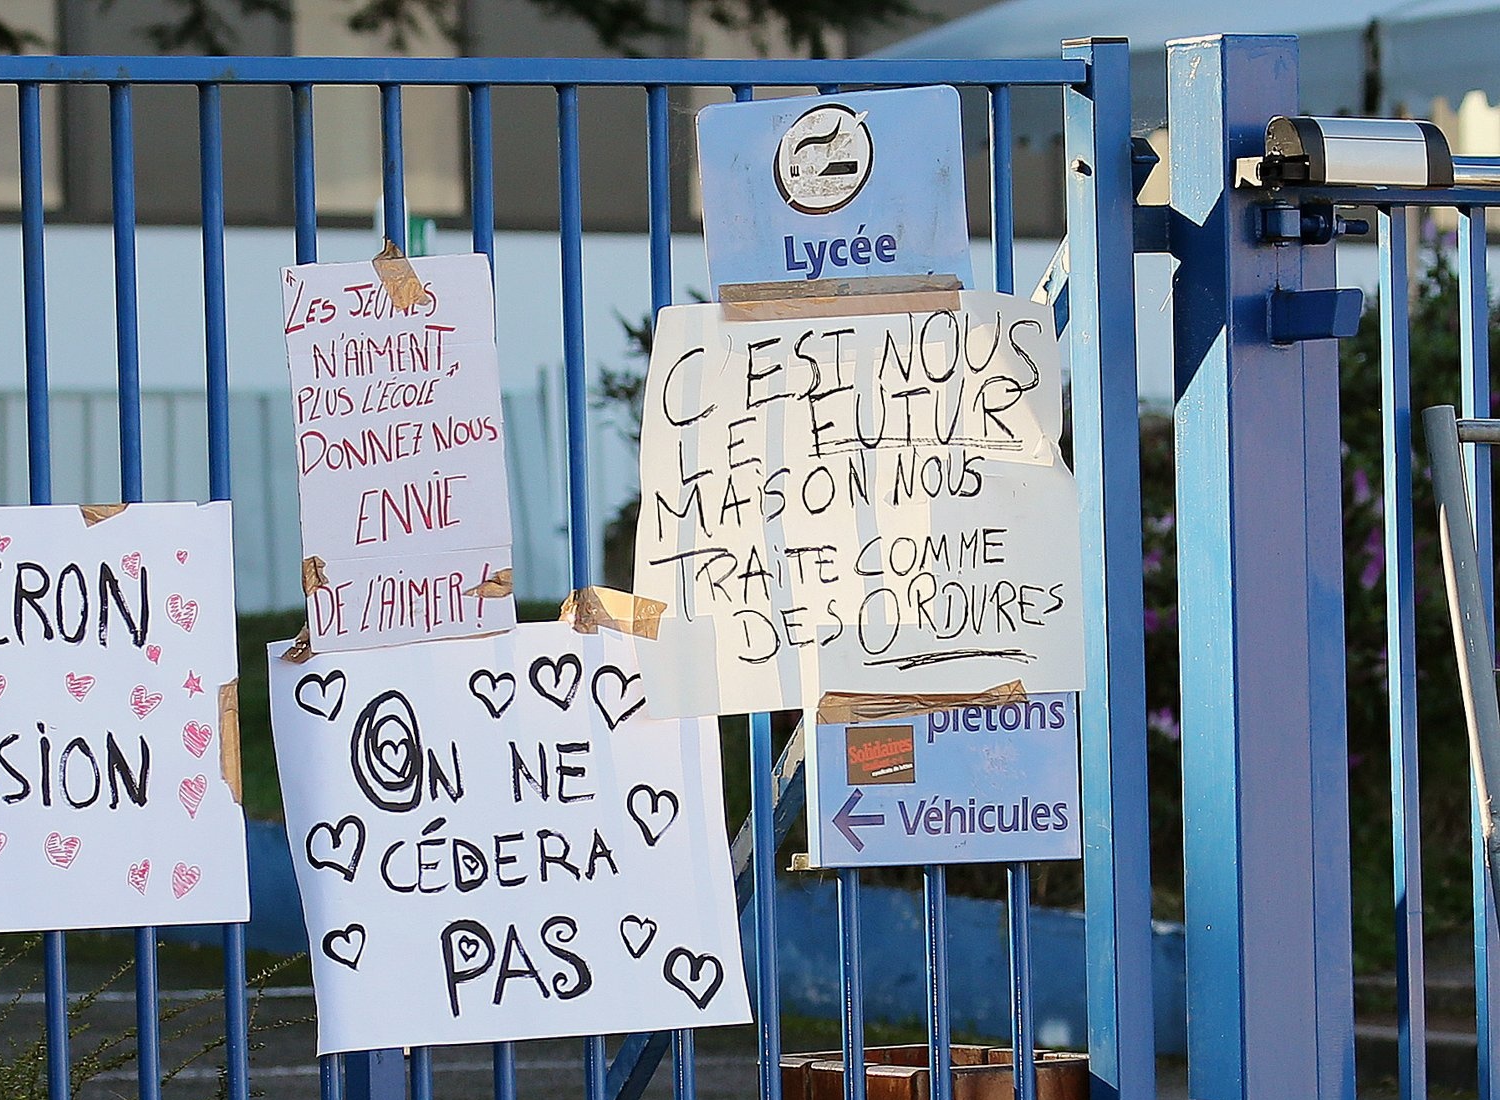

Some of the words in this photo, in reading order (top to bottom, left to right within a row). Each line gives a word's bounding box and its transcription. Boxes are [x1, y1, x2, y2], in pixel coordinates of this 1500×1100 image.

[783, 224, 897, 280] Lycée
[878, 308, 1043, 393] NOUS
[297, 386, 354, 425] PLUS
[299, 422, 424, 477] DONNEZ
[431, 415, 498, 453] NOUS
[678, 416, 763, 486] LE
[892, 447, 986, 506] NOUS
[853, 527, 1008, 577] COMME
[312, 580, 354, 637] DE
[731, 598, 844, 665] DES
[857, 571, 1065, 656] ORDURES
[350, 689, 465, 814] ON
[508, 741, 596, 804] NE
[897, 794, 1069, 836] Véhicules
[379, 816, 620, 894] CÉDERA
[440, 915, 593, 1019] PAS
